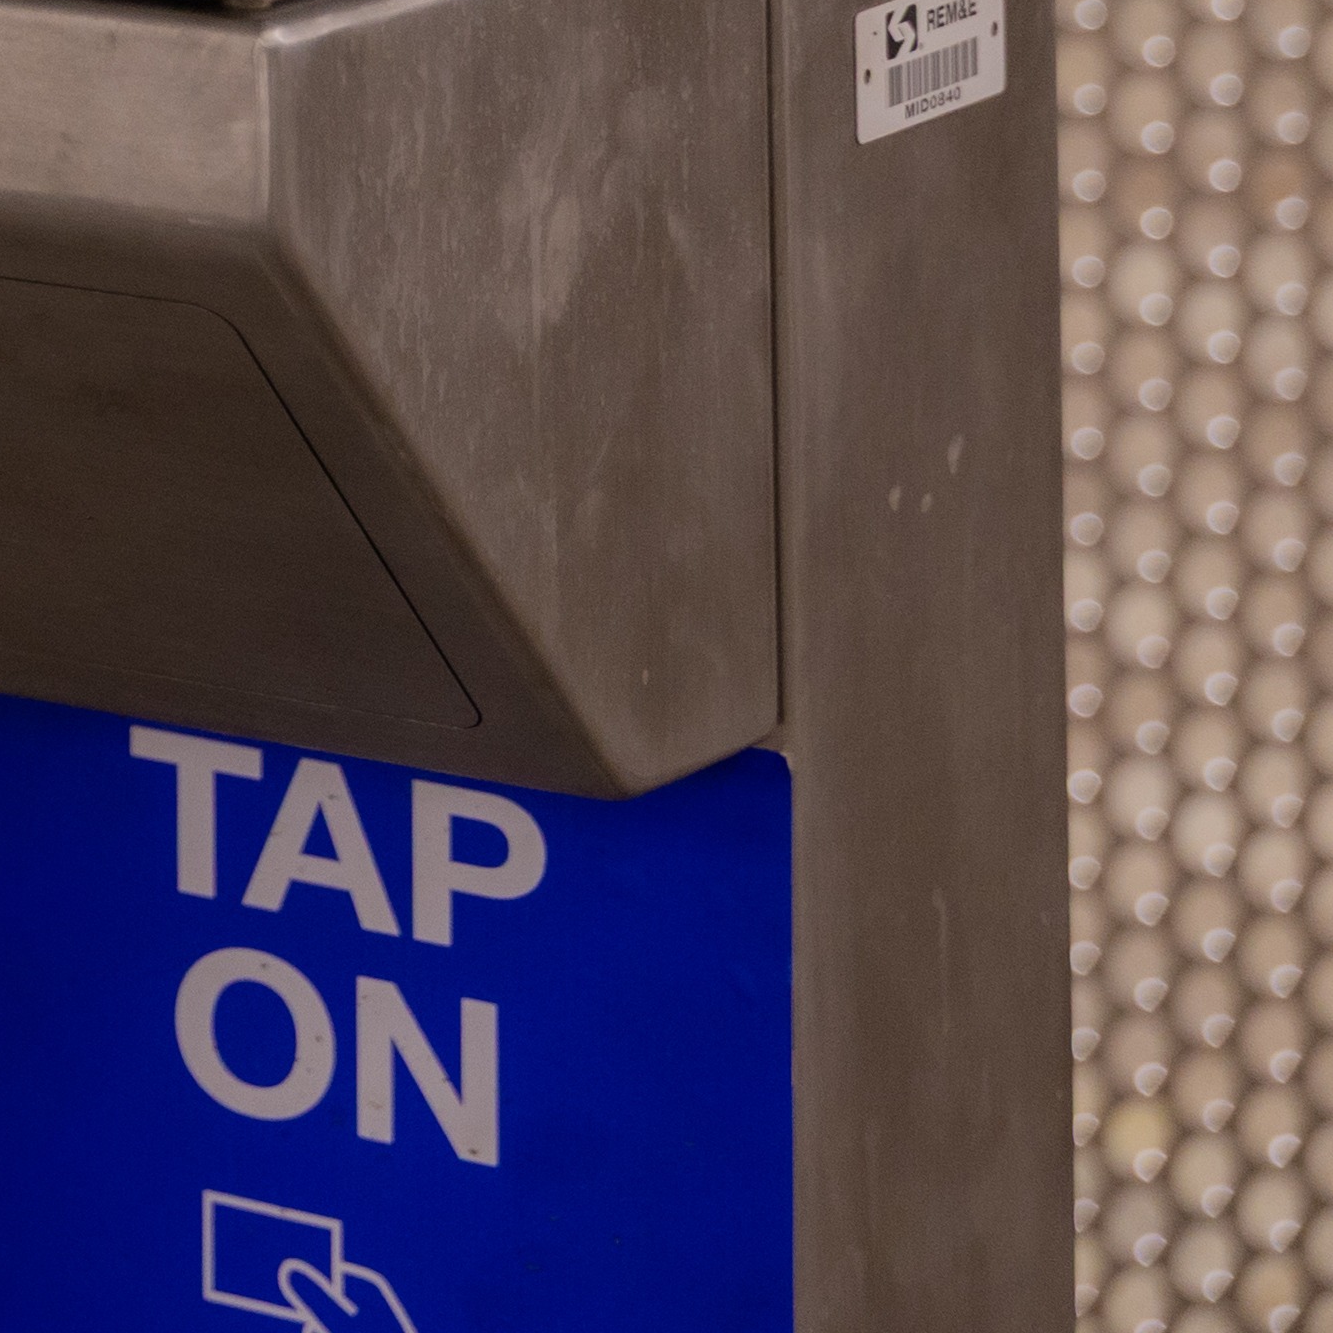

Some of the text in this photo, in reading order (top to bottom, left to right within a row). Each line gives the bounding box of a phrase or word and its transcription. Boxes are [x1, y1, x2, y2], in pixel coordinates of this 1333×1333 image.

[905, 87, 961, 119] MID0840
[130, 725, 547, 947] TAP
[174, 946, 499, 1168] ON
